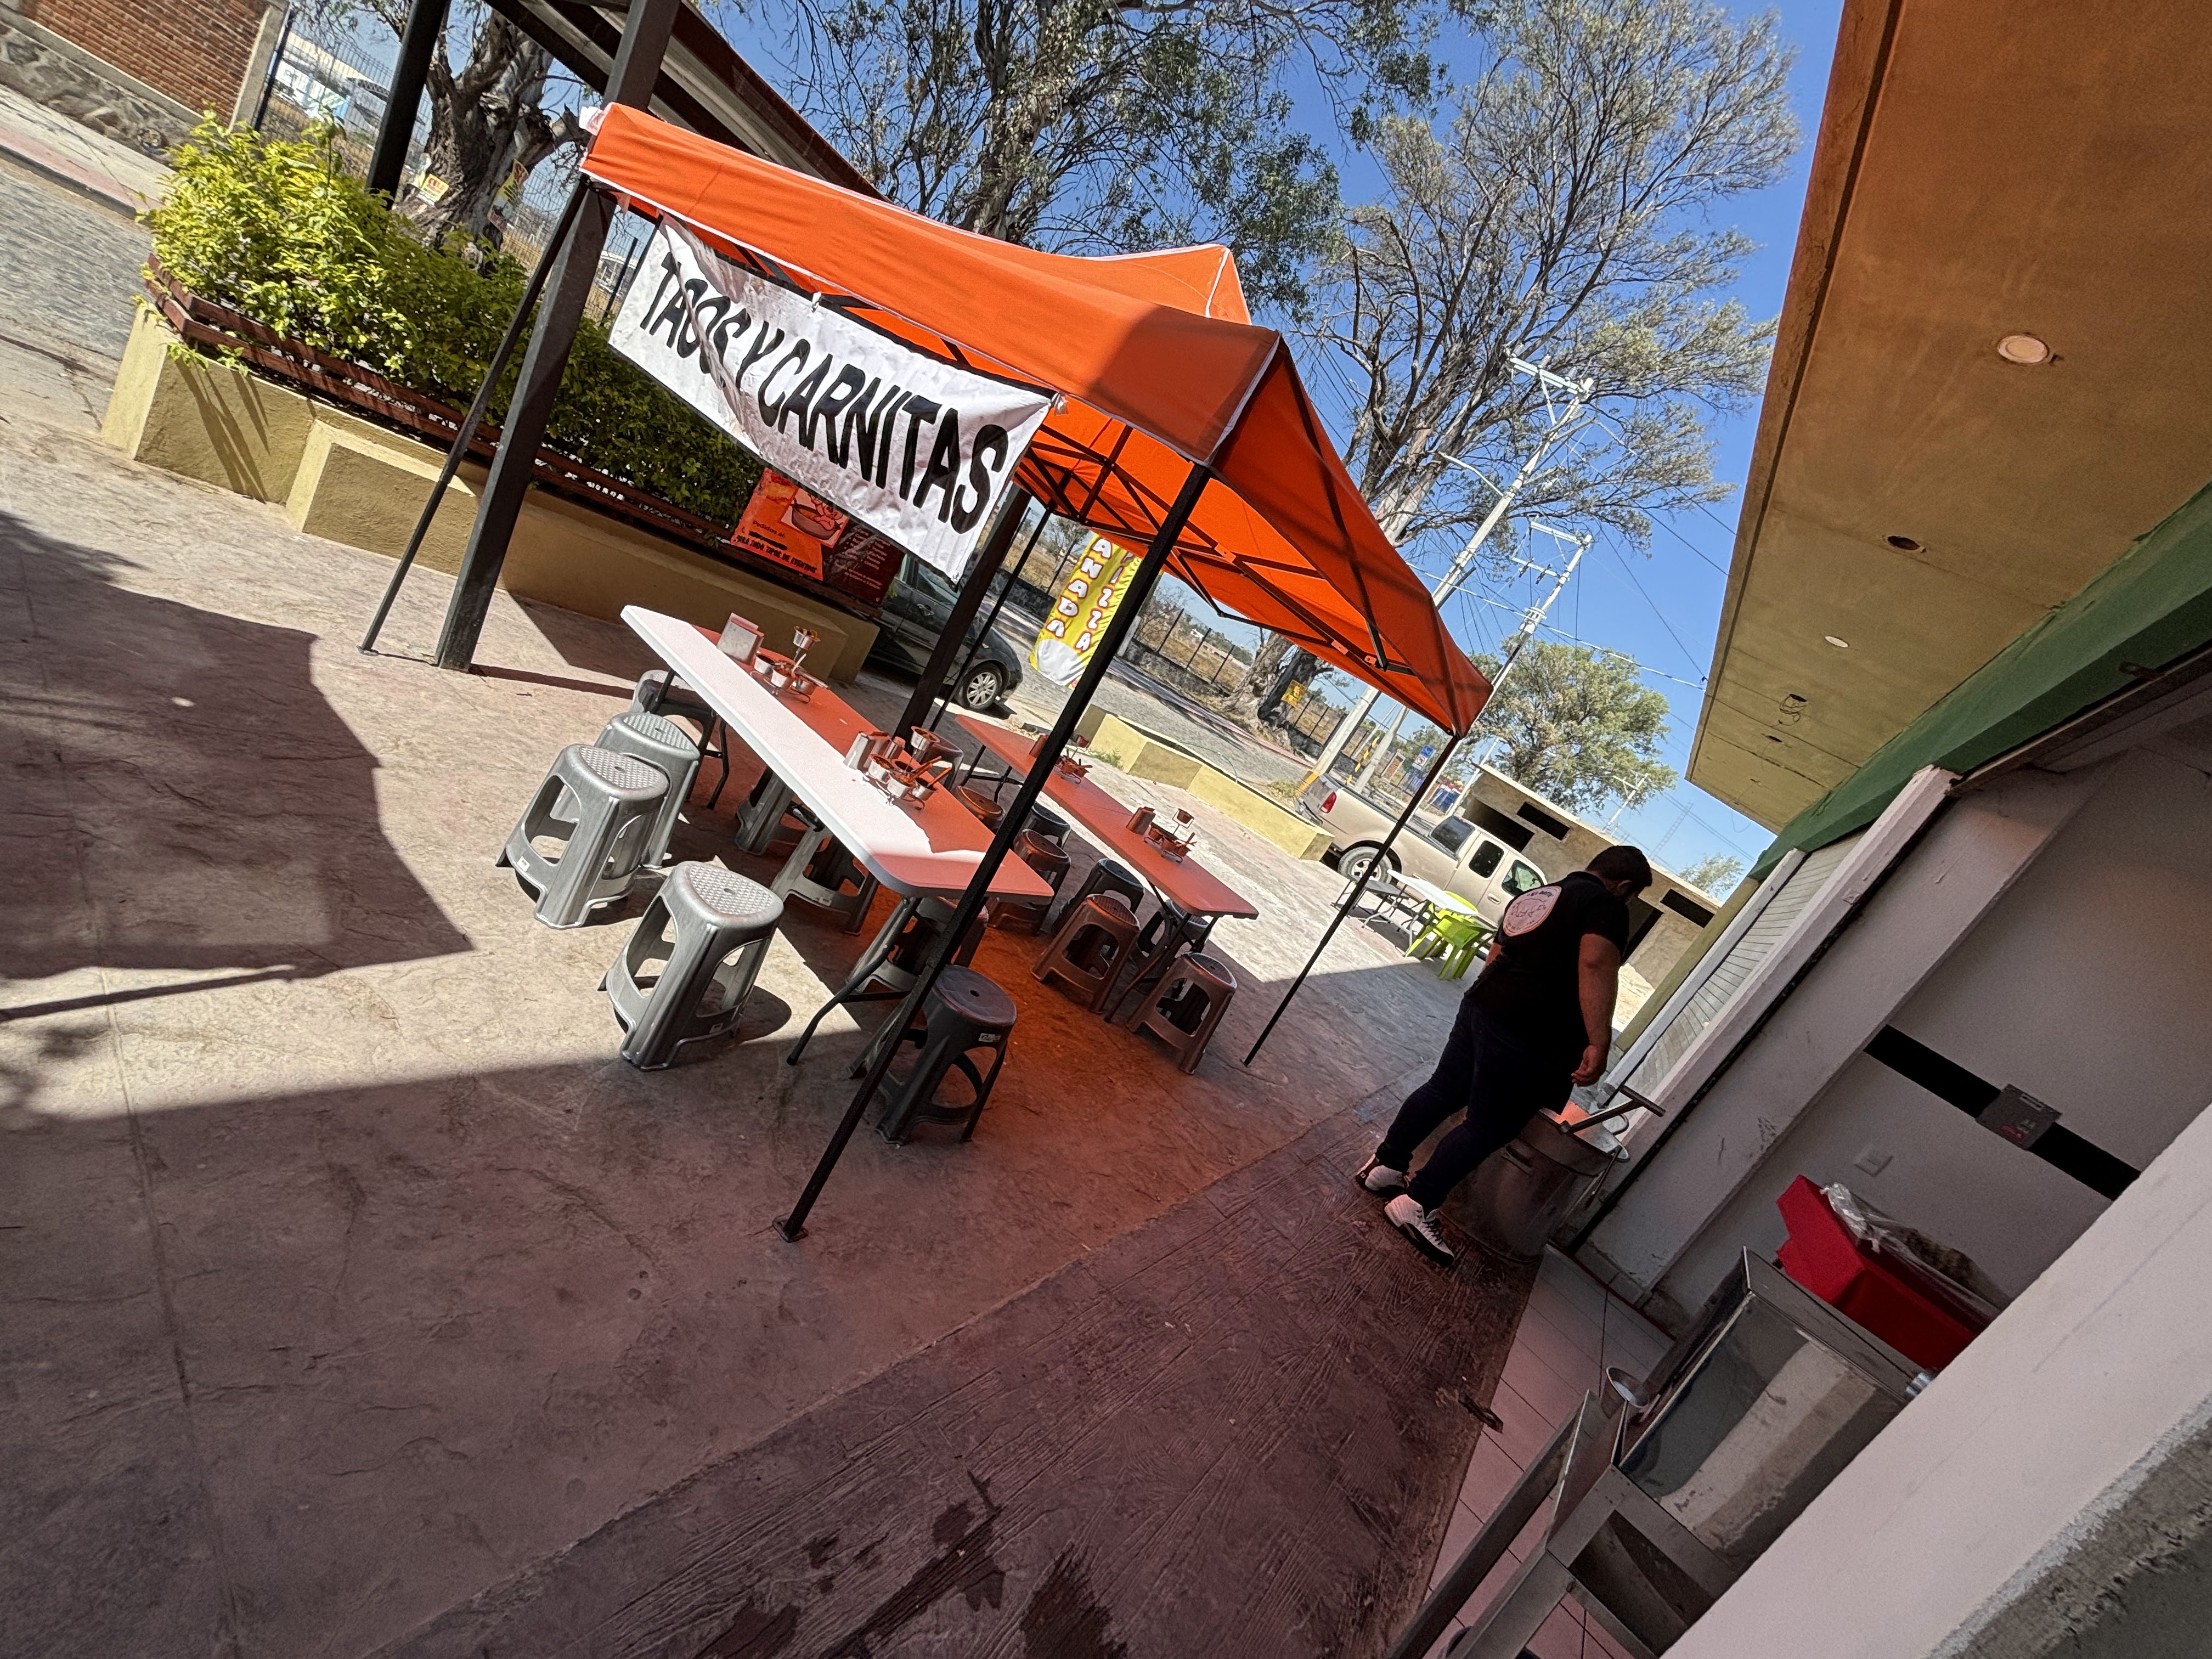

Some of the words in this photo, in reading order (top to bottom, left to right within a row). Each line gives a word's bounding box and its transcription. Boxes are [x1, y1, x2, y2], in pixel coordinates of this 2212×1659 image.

[640, 251, 752, 388] TACOS
[736, 320, 785, 390] Y
[757, 338, 1008, 534] CARNITAS
